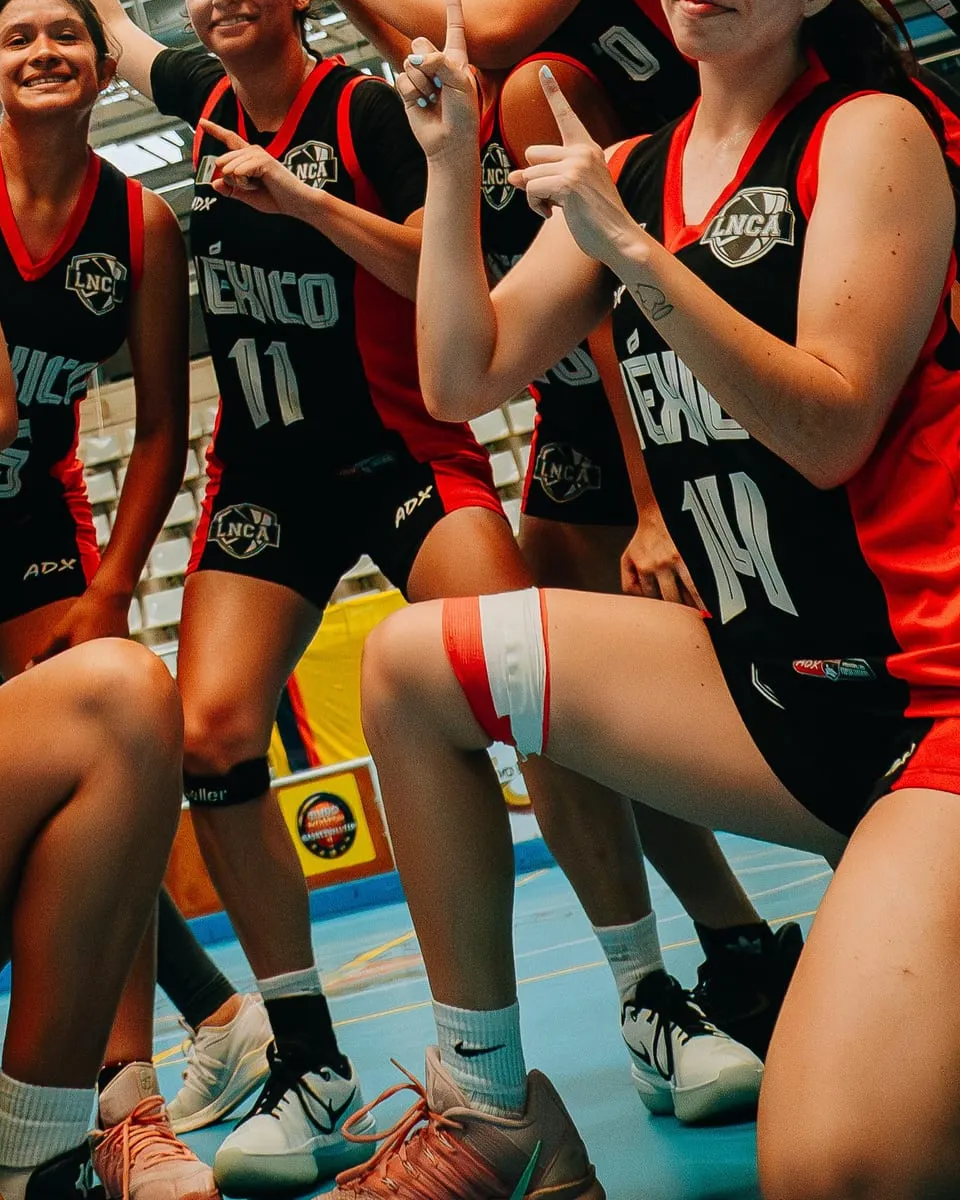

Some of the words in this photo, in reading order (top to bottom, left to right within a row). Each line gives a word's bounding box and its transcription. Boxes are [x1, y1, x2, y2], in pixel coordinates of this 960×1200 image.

[710, 213, 782, 238] LNCA
[74, 272, 114, 293] LNC
[195, 241, 340, 329] ÉXICO
[227, 337, 305, 429] 11
[394, 485, 434, 529] ADX
[217, 522, 270, 542] LNCA
[681, 471, 800, 625] 14
[23, 559, 77, 581] ADX
